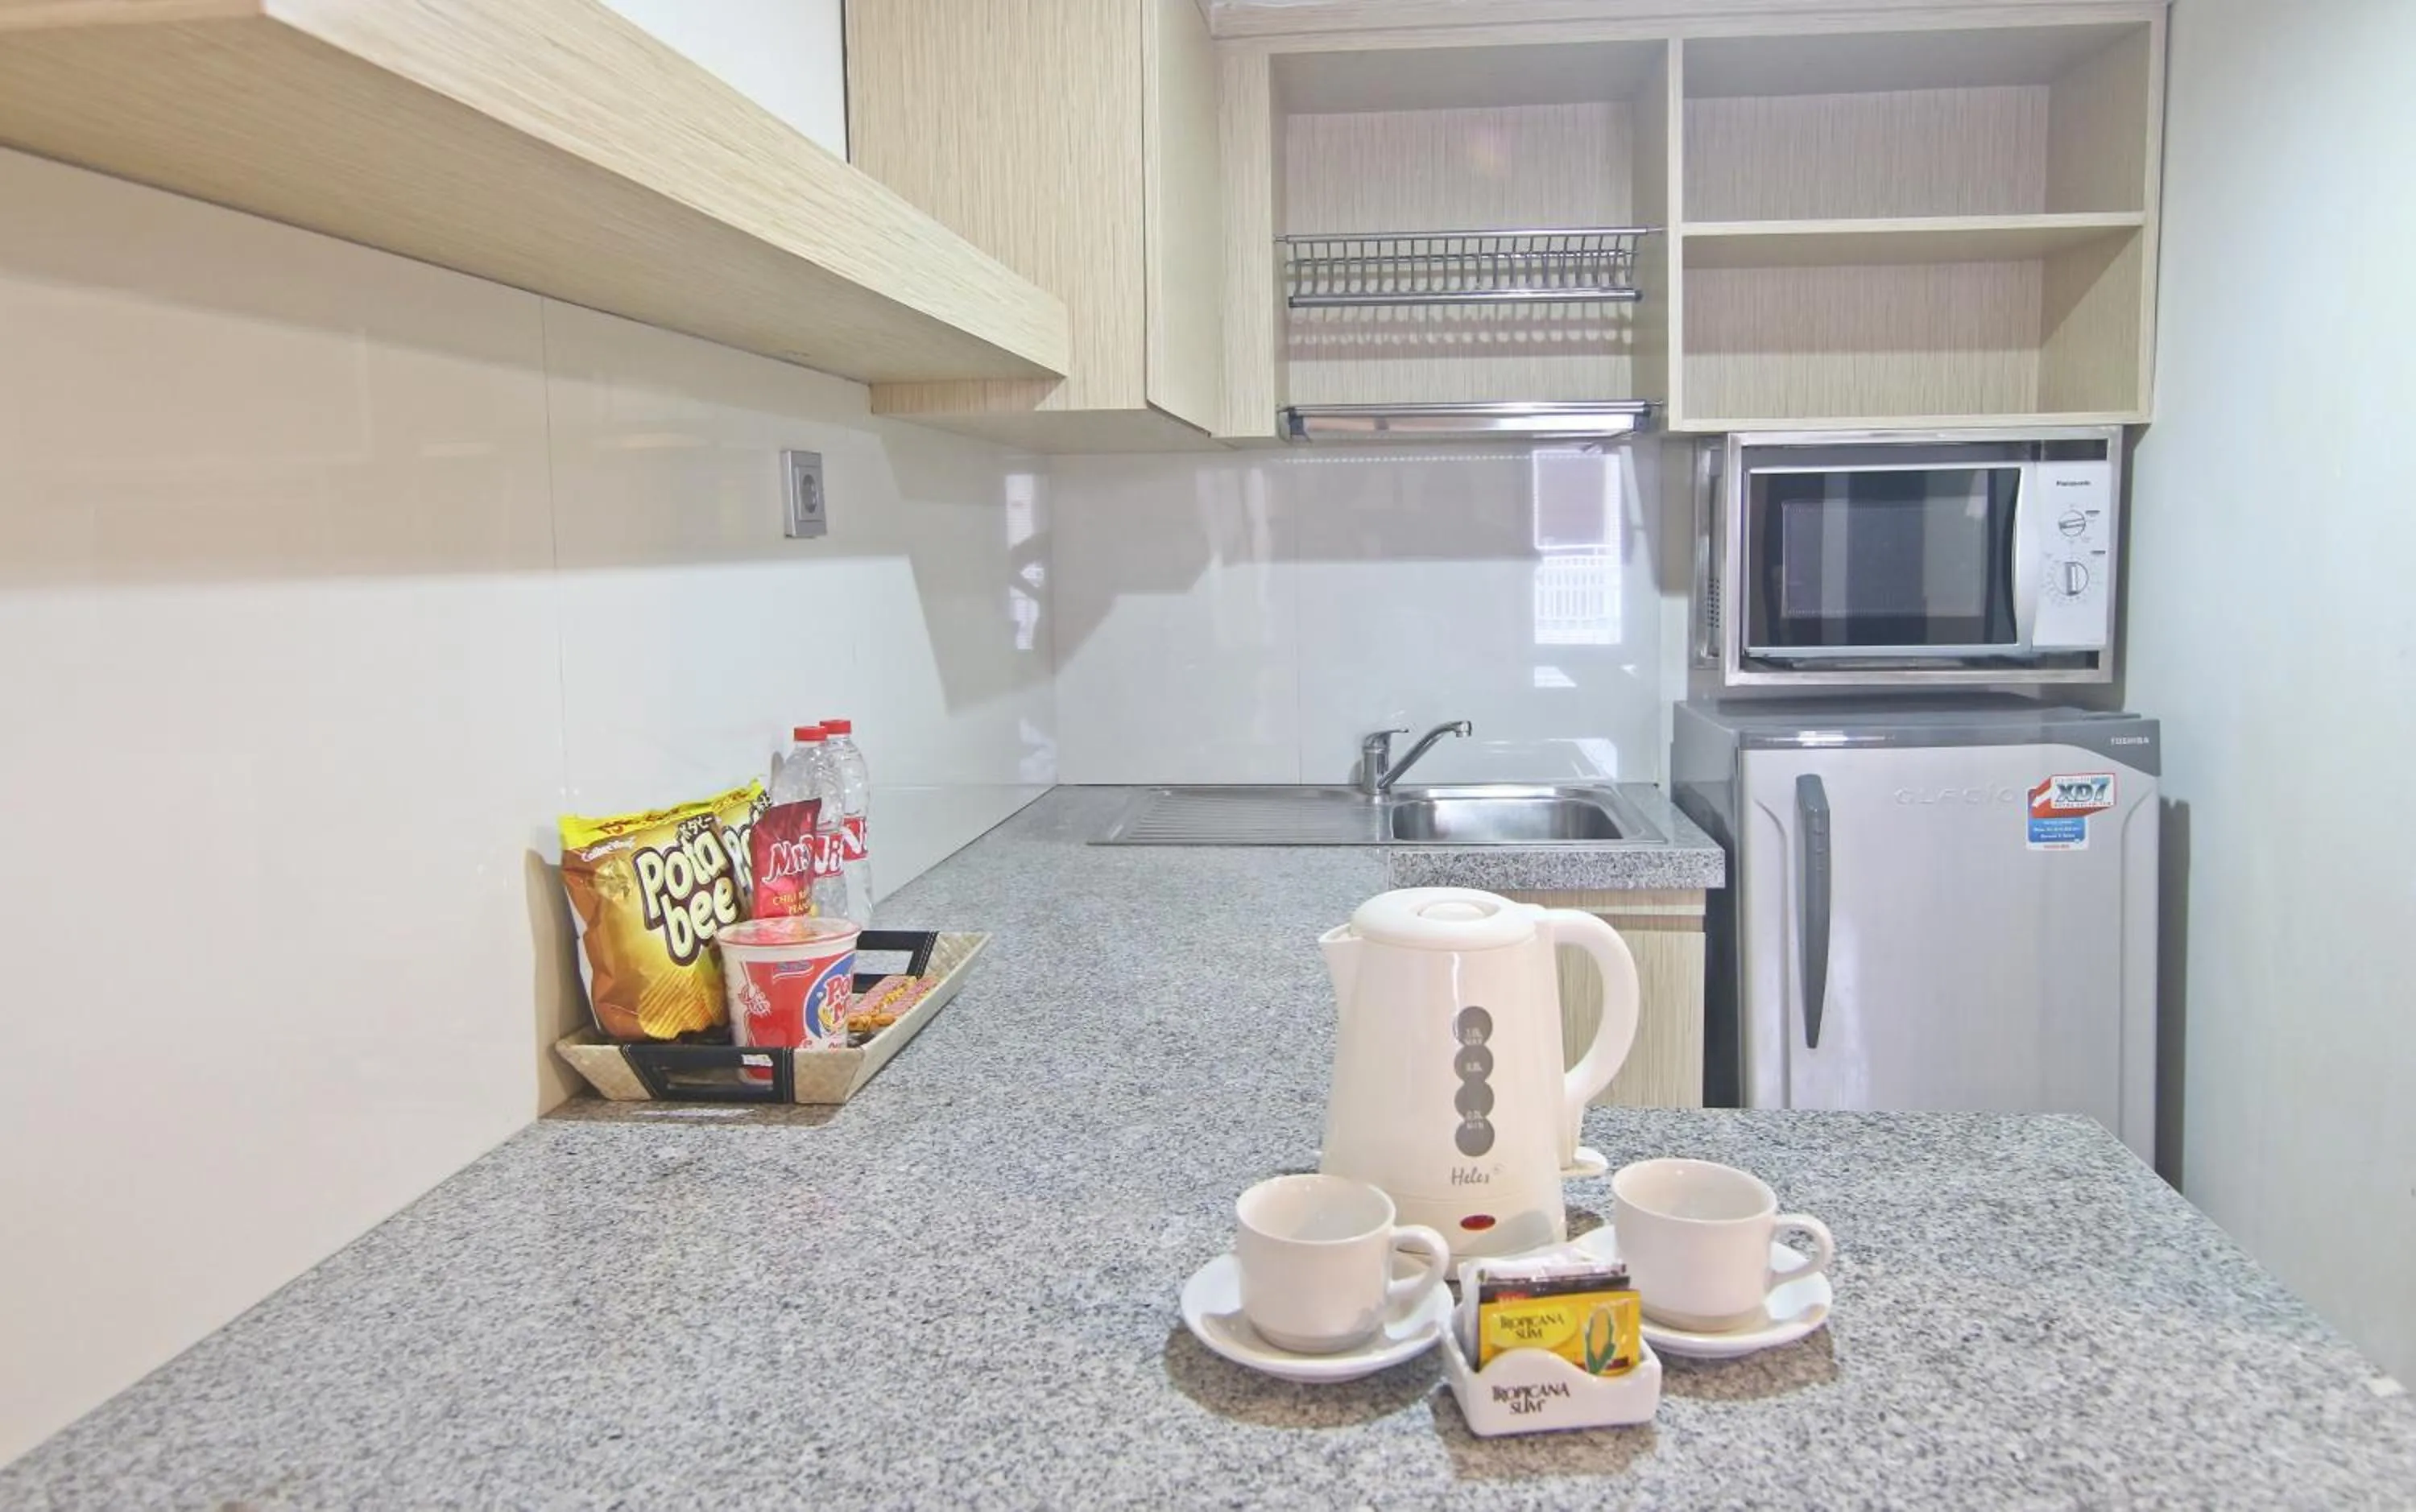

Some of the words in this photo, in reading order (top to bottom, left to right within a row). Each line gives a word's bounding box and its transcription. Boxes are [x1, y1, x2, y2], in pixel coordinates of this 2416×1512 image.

[633, 829, 728, 920] Pota
[664, 876, 738, 960] bee
[1500, 1313, 1565, 1328] TROPICANA
[1516, 1328, 1543, 1340] SLIM
[1492, 1382, 1570, 1402] TROPICANA
[1509, 1398, 1544, 1415] SLIM
